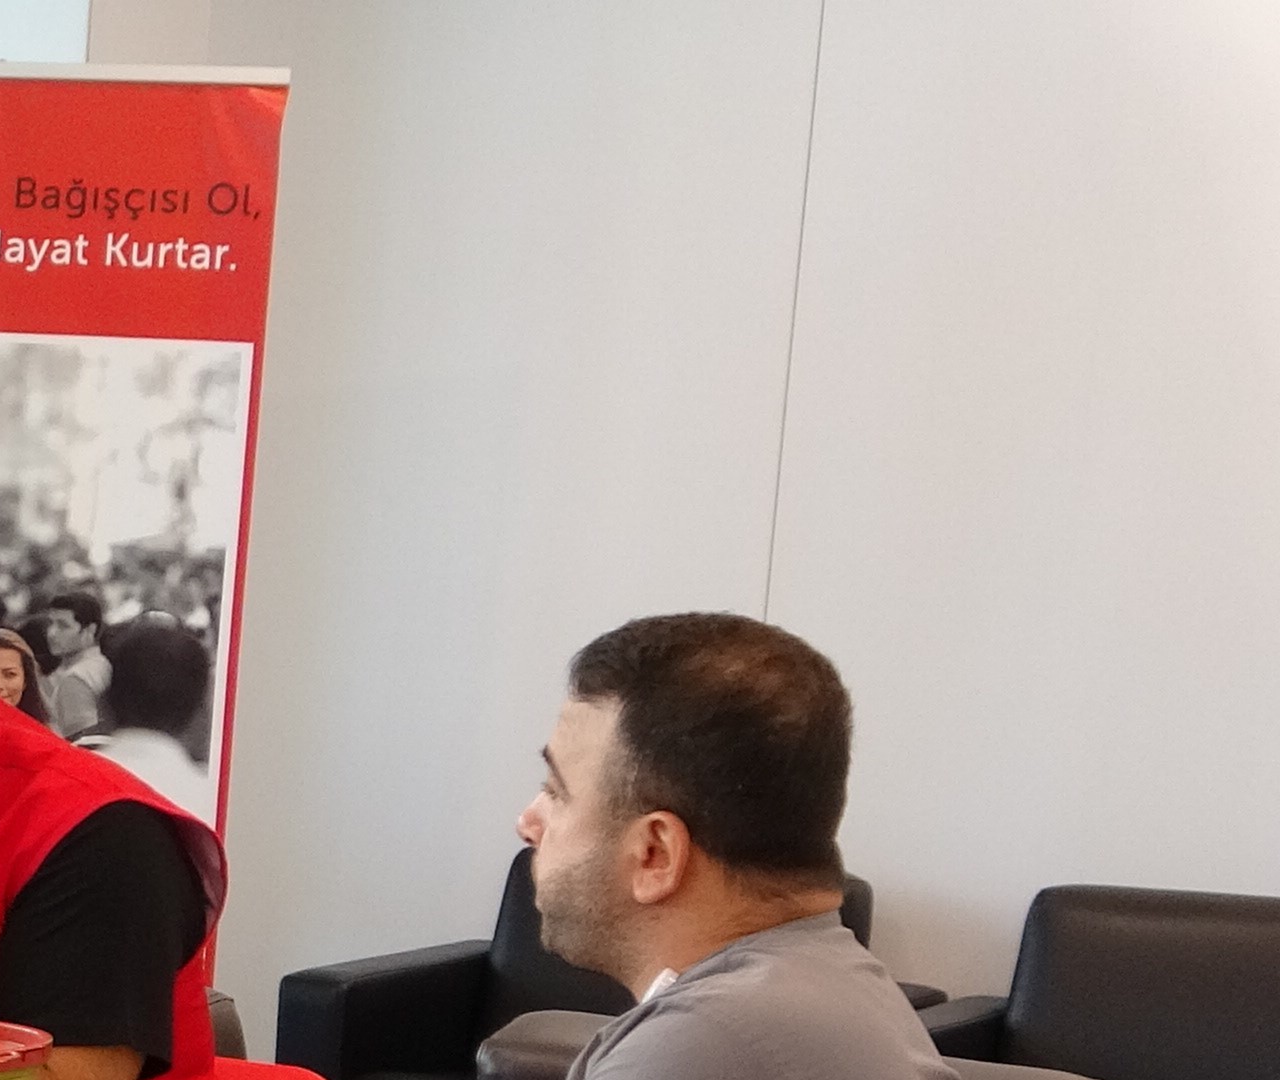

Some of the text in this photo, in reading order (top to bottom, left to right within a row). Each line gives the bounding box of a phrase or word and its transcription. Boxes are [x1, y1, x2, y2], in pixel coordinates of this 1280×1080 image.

[15, 176, 189, 220] Bağışçısı
[207, 182, 260, 220] Ol,
[105, 232, 237, 272] Kurtar.
